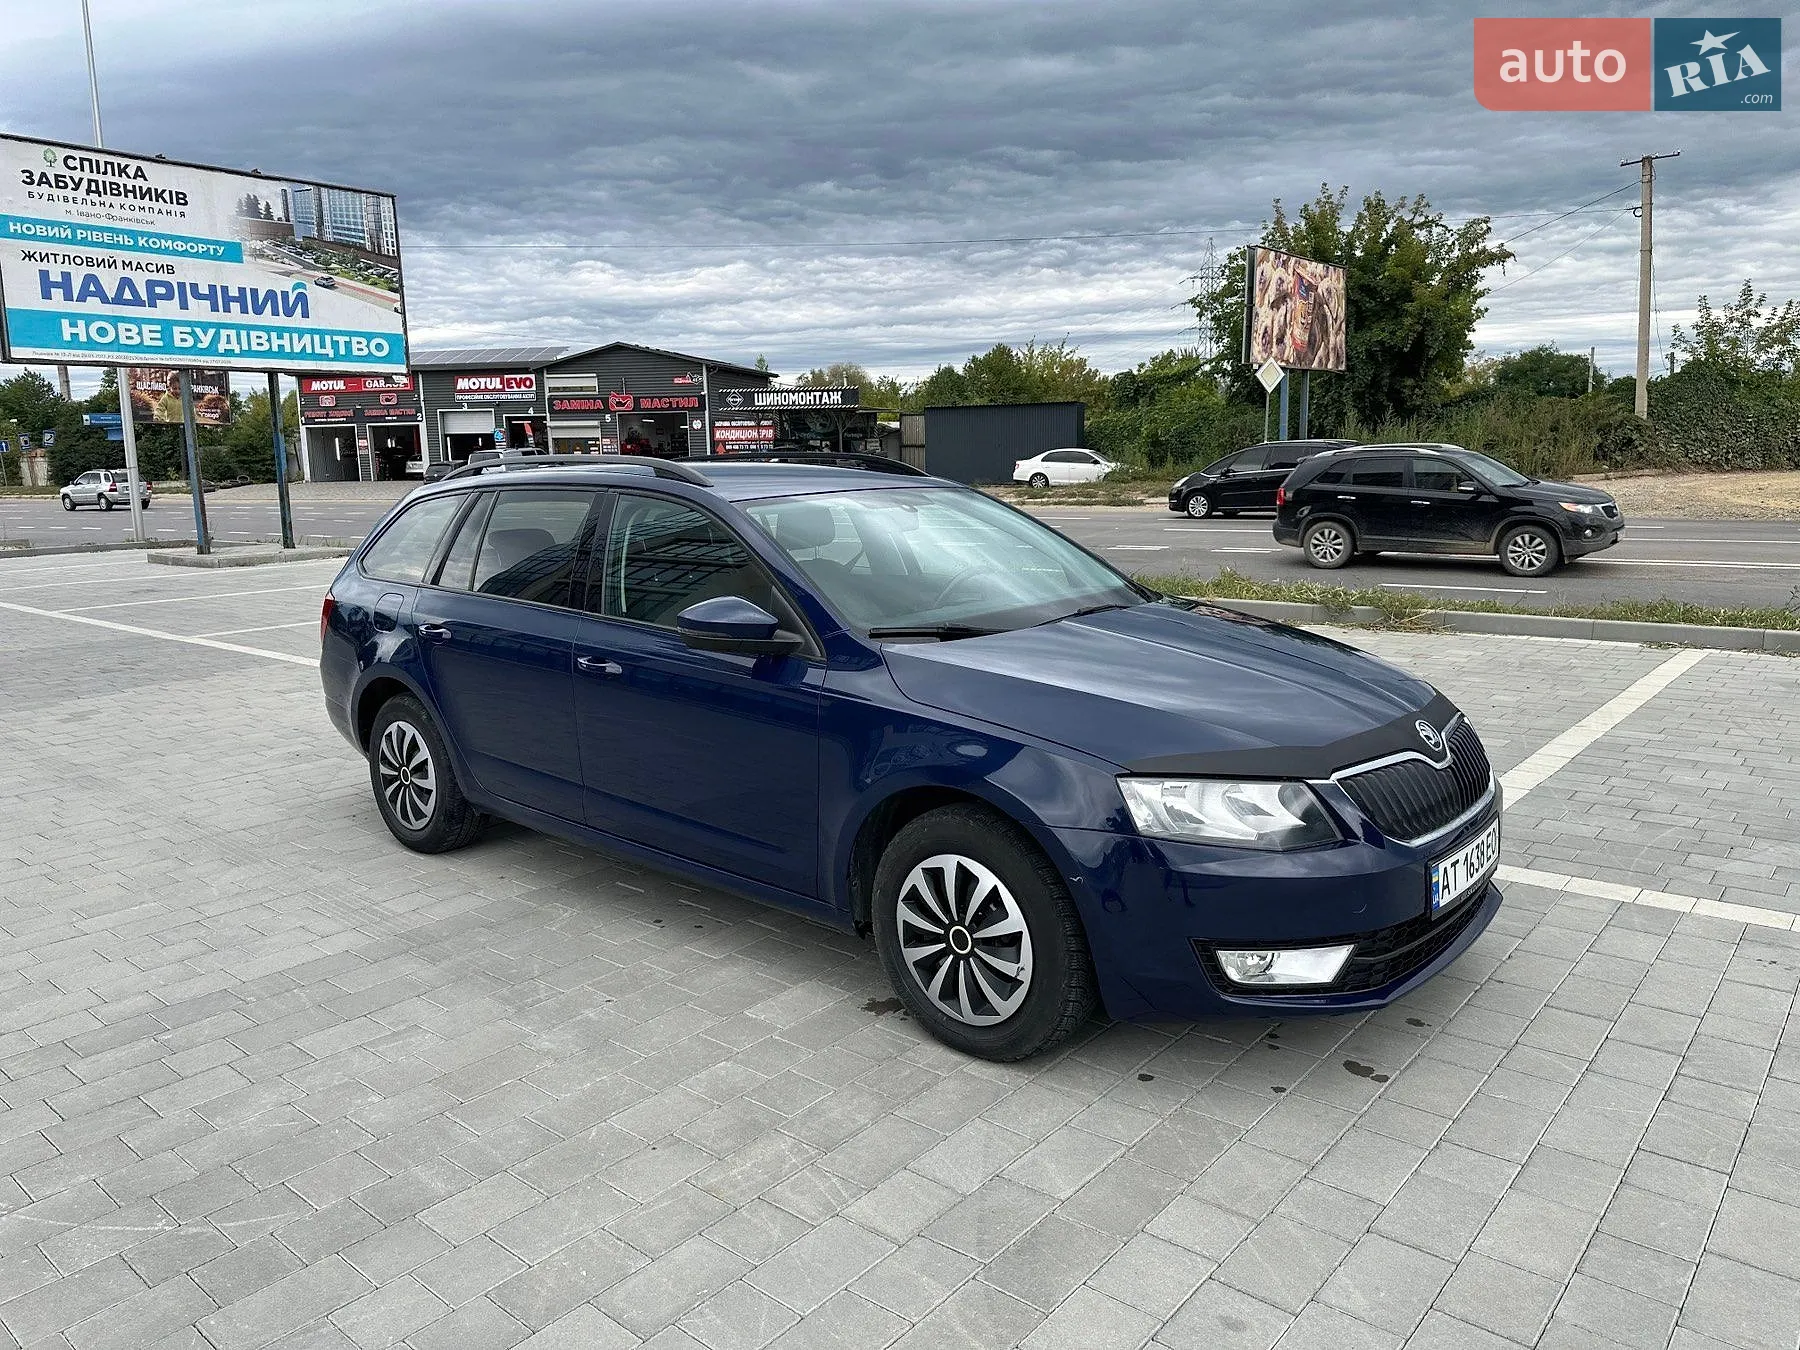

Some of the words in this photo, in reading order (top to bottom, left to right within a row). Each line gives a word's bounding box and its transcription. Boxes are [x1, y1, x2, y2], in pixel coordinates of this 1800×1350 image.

[63, 155, 148, 181] СПІЛКА
[20, 169, 189, 206] ЗАБУДІВНИКІВ
[28, 191, 115, 209] БУДІВЕЛЬНА
[119, 203, 186, 218] КОМПАНІЯ
[77, 209, 156, 226] Івано-Франківськ
[9, 221, 72, 239] НОВИЙ
[76, 229, 134, 246] РІВЕНЬ
[138, 236, 225, 256] КОМФОРТУ
[21, 249, 118, 270] ЖИТЛОВИЙ
[122, 261, 175, 275] МАСИВ
[38, 269, 310, 318] НАДРІЧНИЙ
[61, 318, 164, 346] НОВЕ
[172, 326, 390, 358] БУДІВНИЦТВО
[311, 380, 346, 391] MOTUL
[456, 377, 503, 390] MOTUL
[506, 377, 534, 389] EVO
[553, 399, 604, 410] ЗАМІНА
[640, 397, 699, 409] МАСТИЛ
[754, 391, 842, 406] ШИНОМОНТАЖ
[417, 413, 423, 421] 2
[528, 407, 534, 415] 4
[605, 414, 611, 423] 5
[1441, 859, 1459, 899] AT
[1463, 840, 1485, 882] 1638
[1486, 828, 1497, 862] EO
